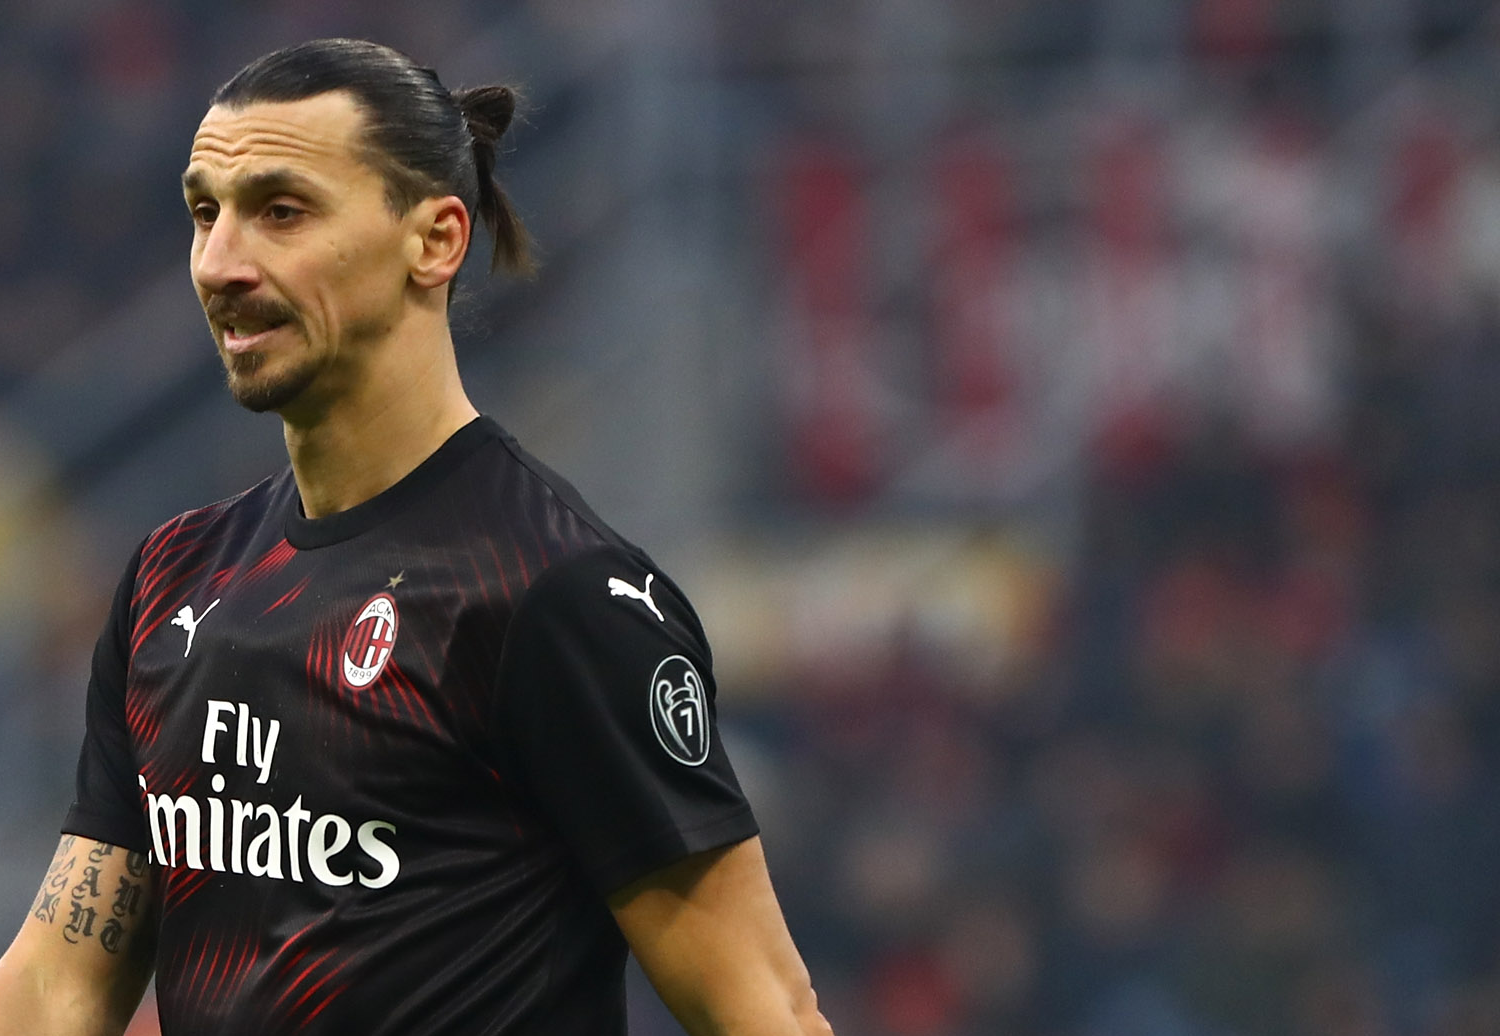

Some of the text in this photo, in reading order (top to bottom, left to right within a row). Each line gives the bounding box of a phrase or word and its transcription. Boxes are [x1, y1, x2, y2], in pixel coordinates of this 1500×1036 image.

[365, 601, 392, 620] ACM
[347, 667, 372, 680] 1899
[201, 700, 281, 784] Fly
[138, 774, 401, 890] mirates
